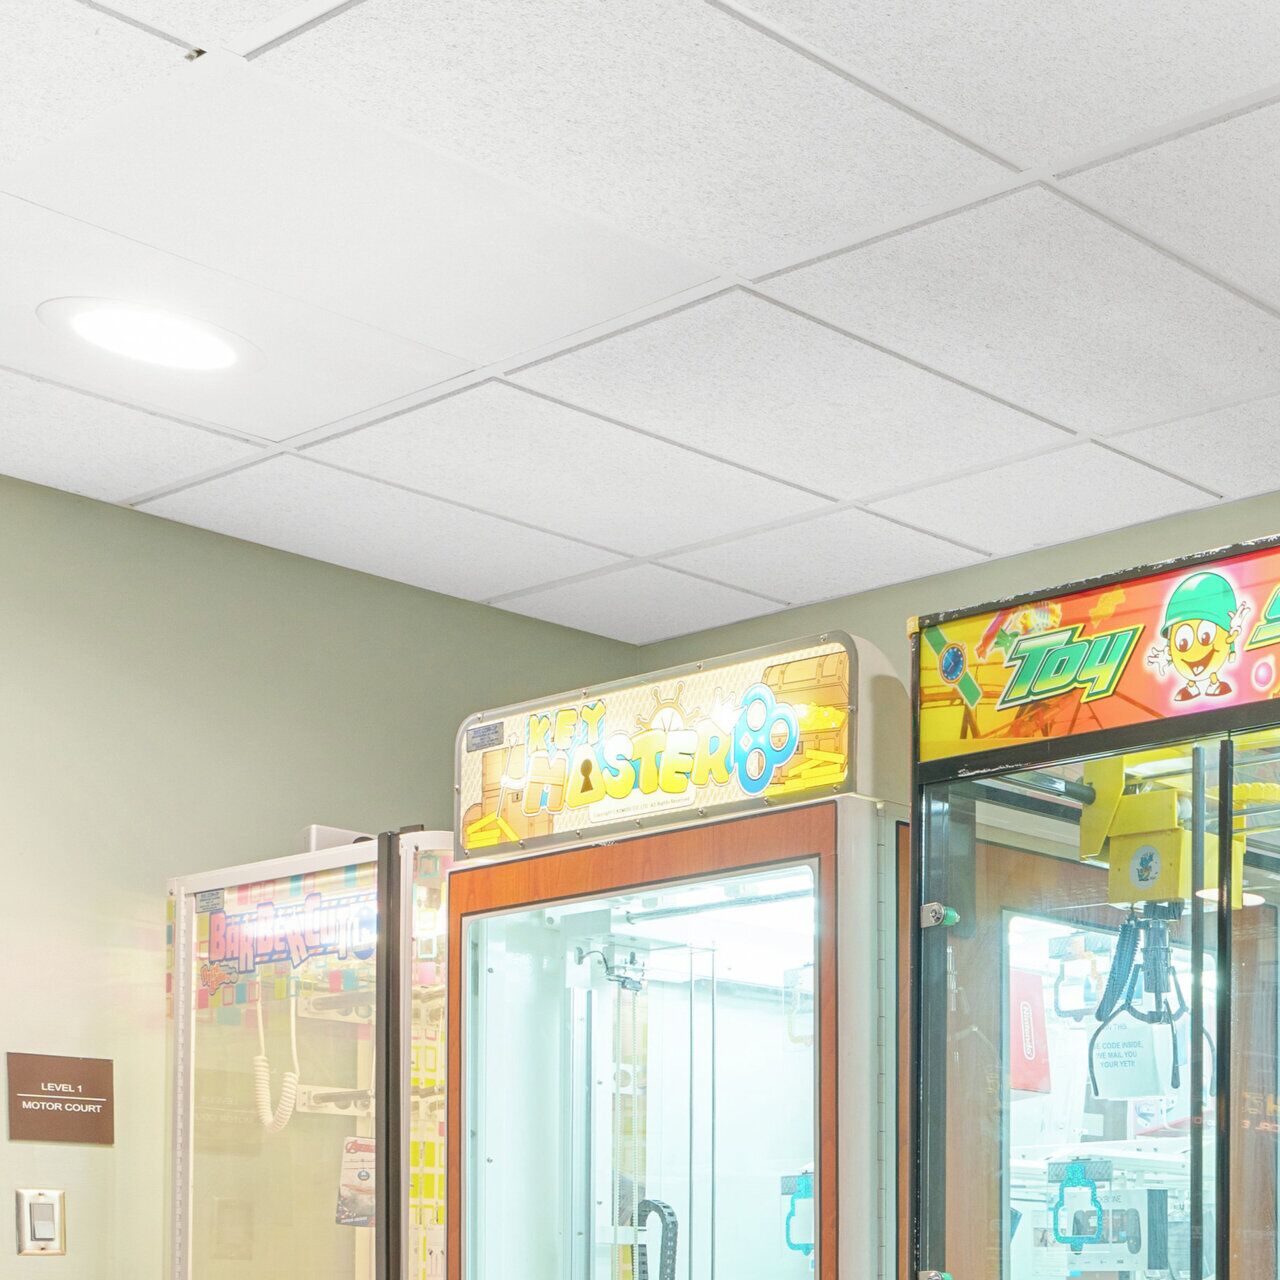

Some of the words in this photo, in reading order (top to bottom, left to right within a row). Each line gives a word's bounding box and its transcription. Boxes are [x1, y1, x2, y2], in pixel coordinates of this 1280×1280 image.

[998, 624, 1145, 710] Toy
[526, 699, 606, 751] KEY
[523, 719, 734, 816] MASTER
[1021, 1003, 1034, 1059] Nintendo
[22, 1101, 62, 1111] MOTOR
[65, 1103, 102, 1113] COURT
[41, 1083, 75, 1092] LEVEL
[77, 1085, 82, 1093] 1
